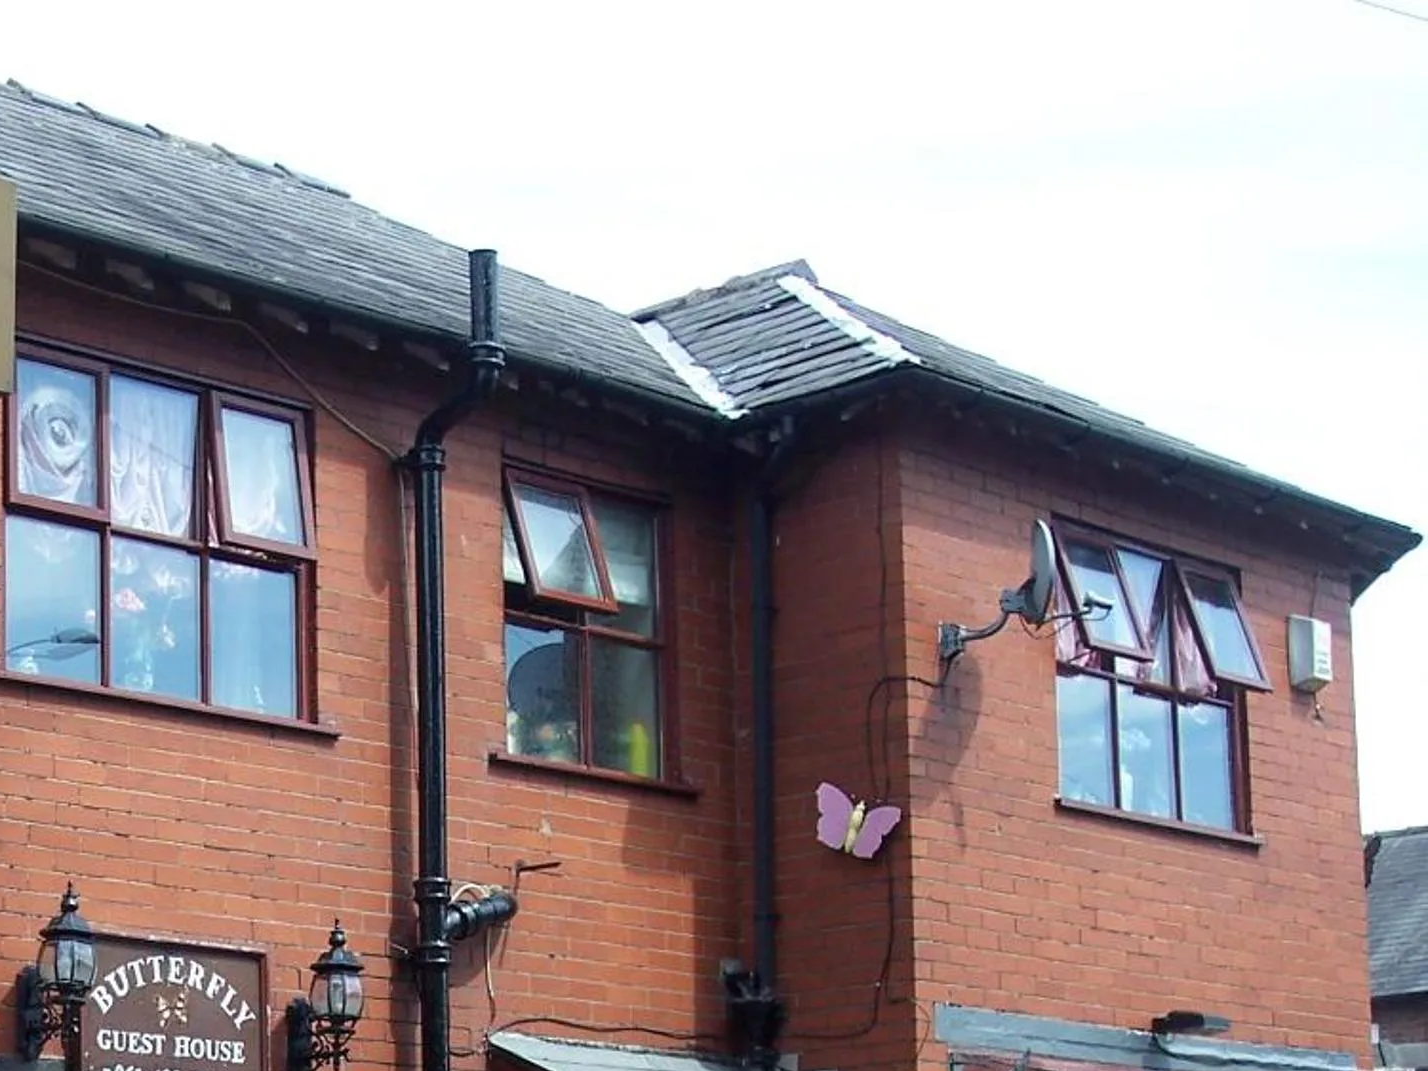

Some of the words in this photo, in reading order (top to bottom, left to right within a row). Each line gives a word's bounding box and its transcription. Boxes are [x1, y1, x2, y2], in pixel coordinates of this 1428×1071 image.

[90, 955, 256, 1031] BUTTERFLY
[97, 1029, 166, 1055] GUEST
[174, 1036, 245, 1064] HOUSE
